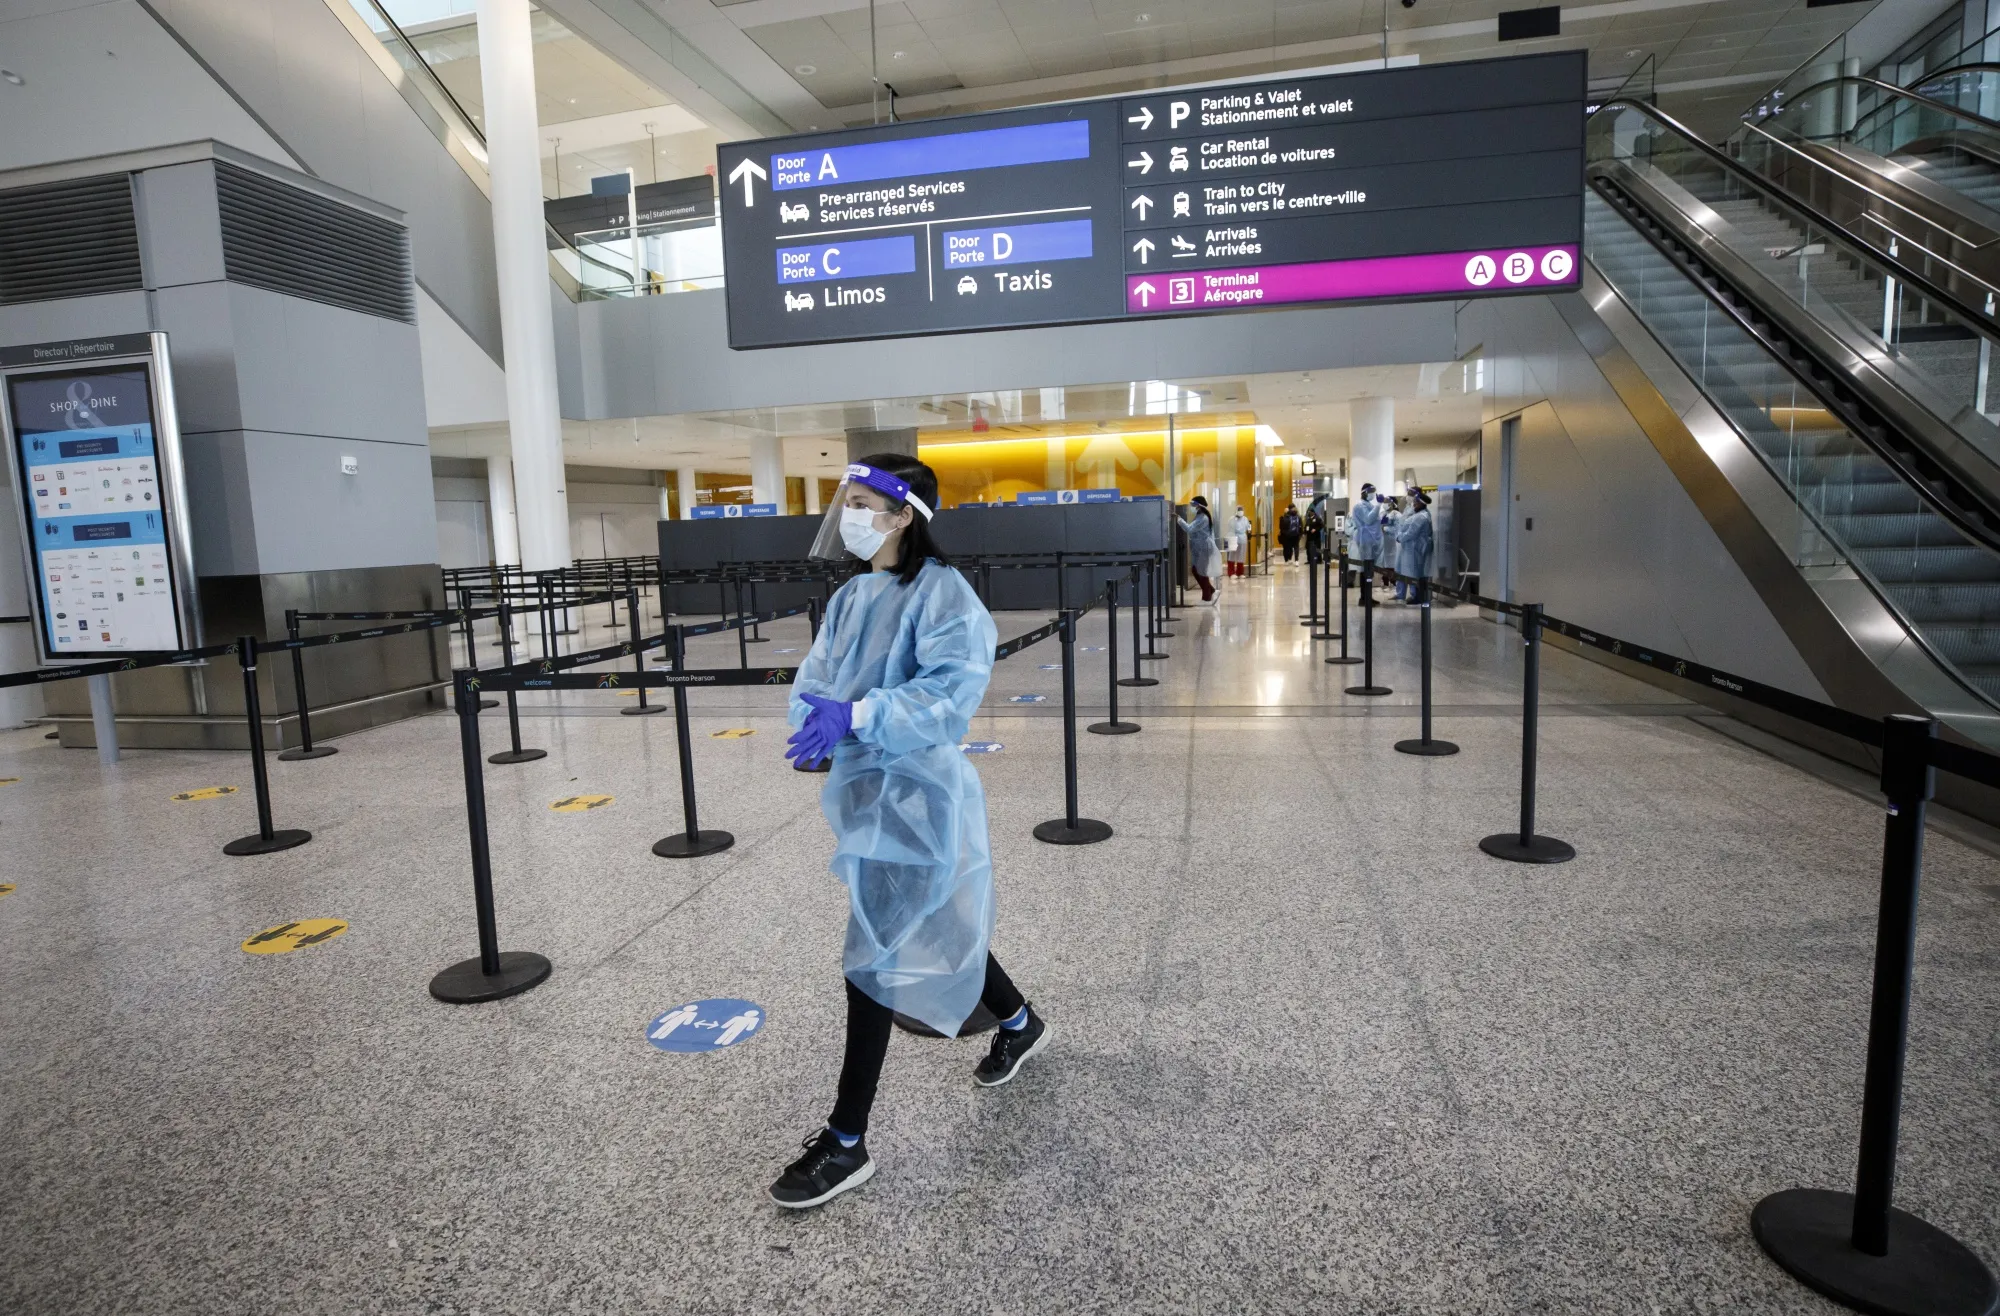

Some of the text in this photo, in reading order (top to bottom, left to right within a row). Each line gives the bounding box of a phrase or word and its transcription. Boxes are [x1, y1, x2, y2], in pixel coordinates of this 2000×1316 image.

[1201, 89, 1301, 111] Parking & Valet
[1171, 102, 1190, 128] P
[1201, 99, 1353, 126] Stationnement et valet
[1201, 137, 1269, 155] Car Rental
[777, 157, 805, 170] Door
[818, 153, 838, 181] A
[1201, 147, 1335, 170] Location de voitures
[778, 170, 811, 185] Porte
[819, 180, 965, 208] Pre-arranged Services
[1204, 182, 1285, 201] Train to City
[653, 206, 695, 218] Stationnement
[820, 199, 935, 223] Services réservés
[1204, 190, 1367, 216] Train vers le centre-ville
[949, 236, 980, 249] Door
[1206, 227, 1258, 242] Arrivals
[992, 232, 1013, 260] D
[1206, 242, 1262, 257] Arrivées
[782, 252, 811, 265] Door
[822, 248, 841, 275] C
[950, 249, 985, 264] Porte
[783, 265, 816, 279] Porte
[1473, 255, 1563, 279] A B C
[994, 269, 1053, 293] Taxis
[1204, 272, 1259, 287] Terminal
[824, 286, 886, 306] Limos
[1175, 283, 1189, 301] 3
[1204, 287, 1264, 304] Aérogare
[33, 342, 115, 358] Directory Répertoire
[50, 400, 79, 413] SHOP
[90, 396, 118, 409] DINE
[37, 668, 81, 680] Toronto Pearson
[524, 678, 552, 686] welcome
[690, 674, 716, 682] Pearson
[1711, 674, 1743, 692] Toronto Pearson
